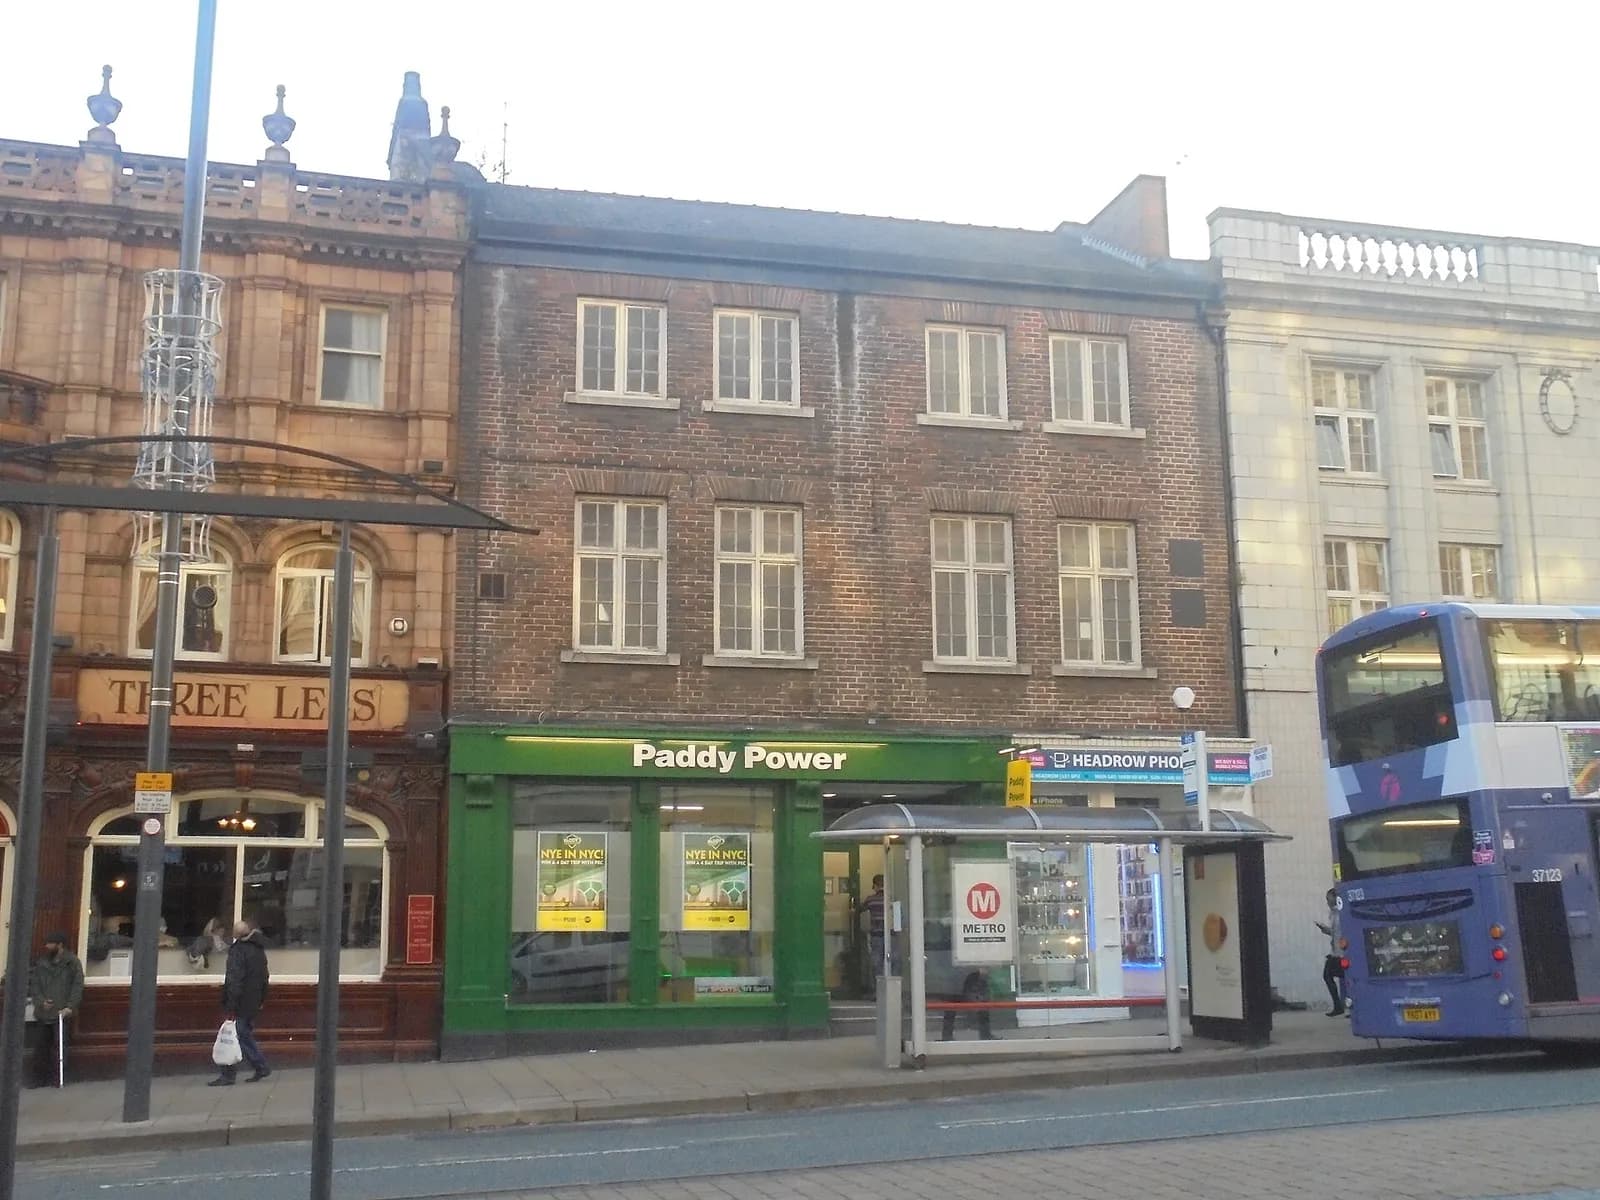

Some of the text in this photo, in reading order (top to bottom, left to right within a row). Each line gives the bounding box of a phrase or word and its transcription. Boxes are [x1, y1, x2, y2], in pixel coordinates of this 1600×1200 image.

[273, 685, 376, 722] LES
[632, 743, 848, 773] Paddy Power
[1073, 754, 1146, 768] HEADROW
[1009, 777, 1024, 787] Paddy
[1009, 792, 1024, 801] Power
[1039, 796, 1064, 804] iPhone
[541, 849, 604, 859] NYE IN NYC!
[686, 850, 747, 860] NYE IN NYC!
[1532, 869, 1562, 882] 37123
[972, 890, 996, 913] M
[963, 923, 1006, 934] METRO
